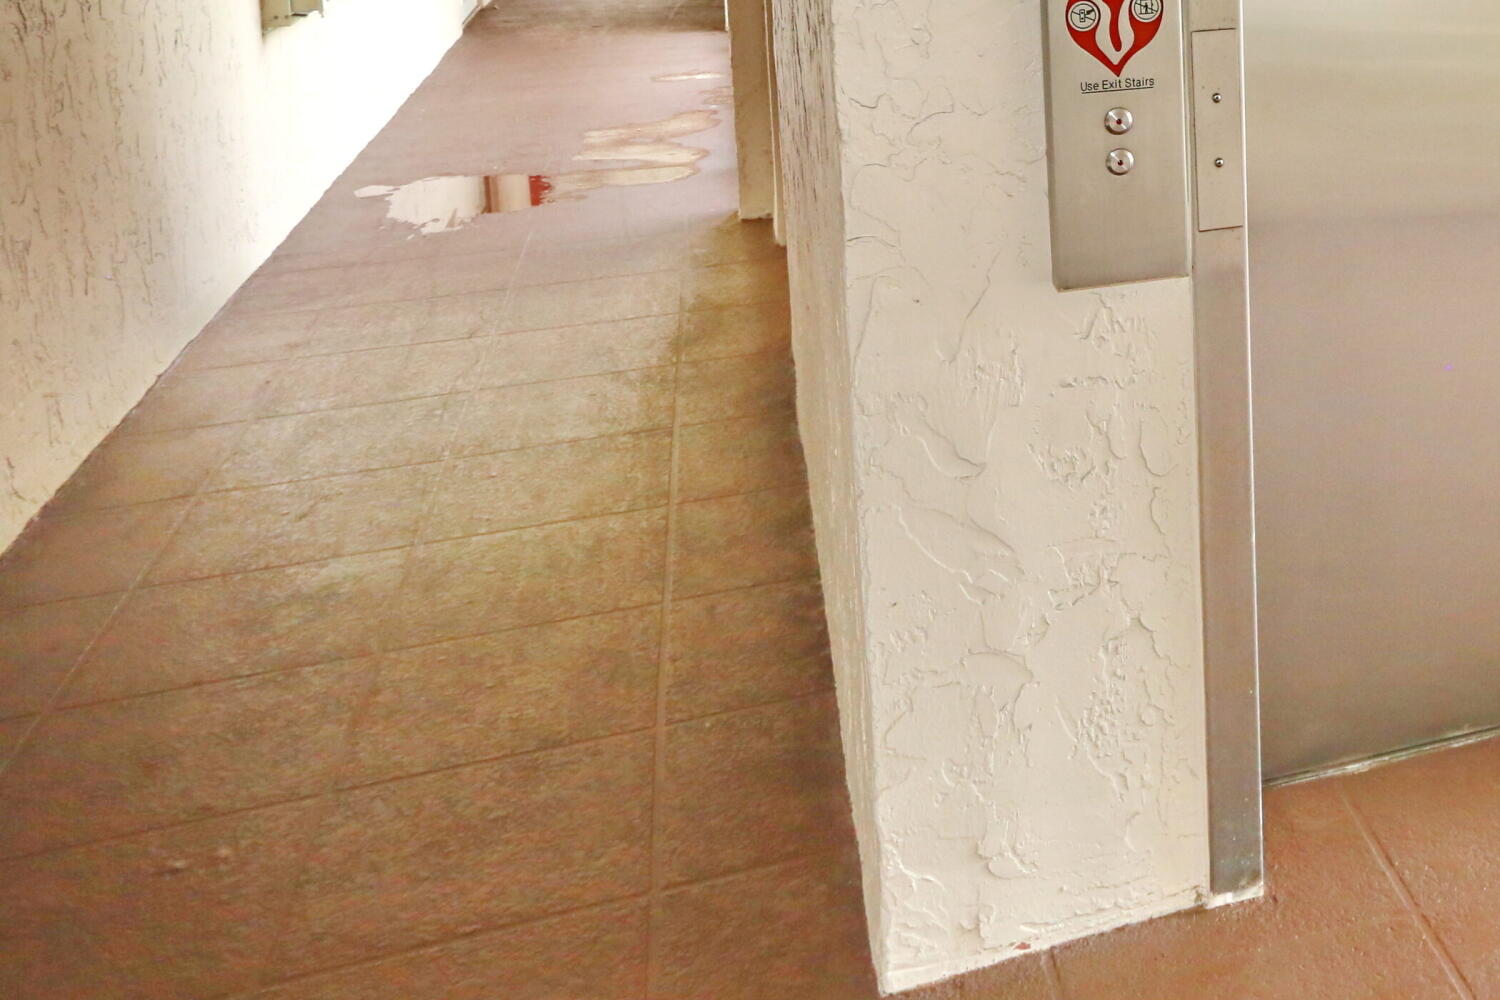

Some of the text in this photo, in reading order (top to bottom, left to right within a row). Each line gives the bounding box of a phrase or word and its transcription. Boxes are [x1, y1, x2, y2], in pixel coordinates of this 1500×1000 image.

[1080, 77, 1155, 92] Use Exit Stairs
